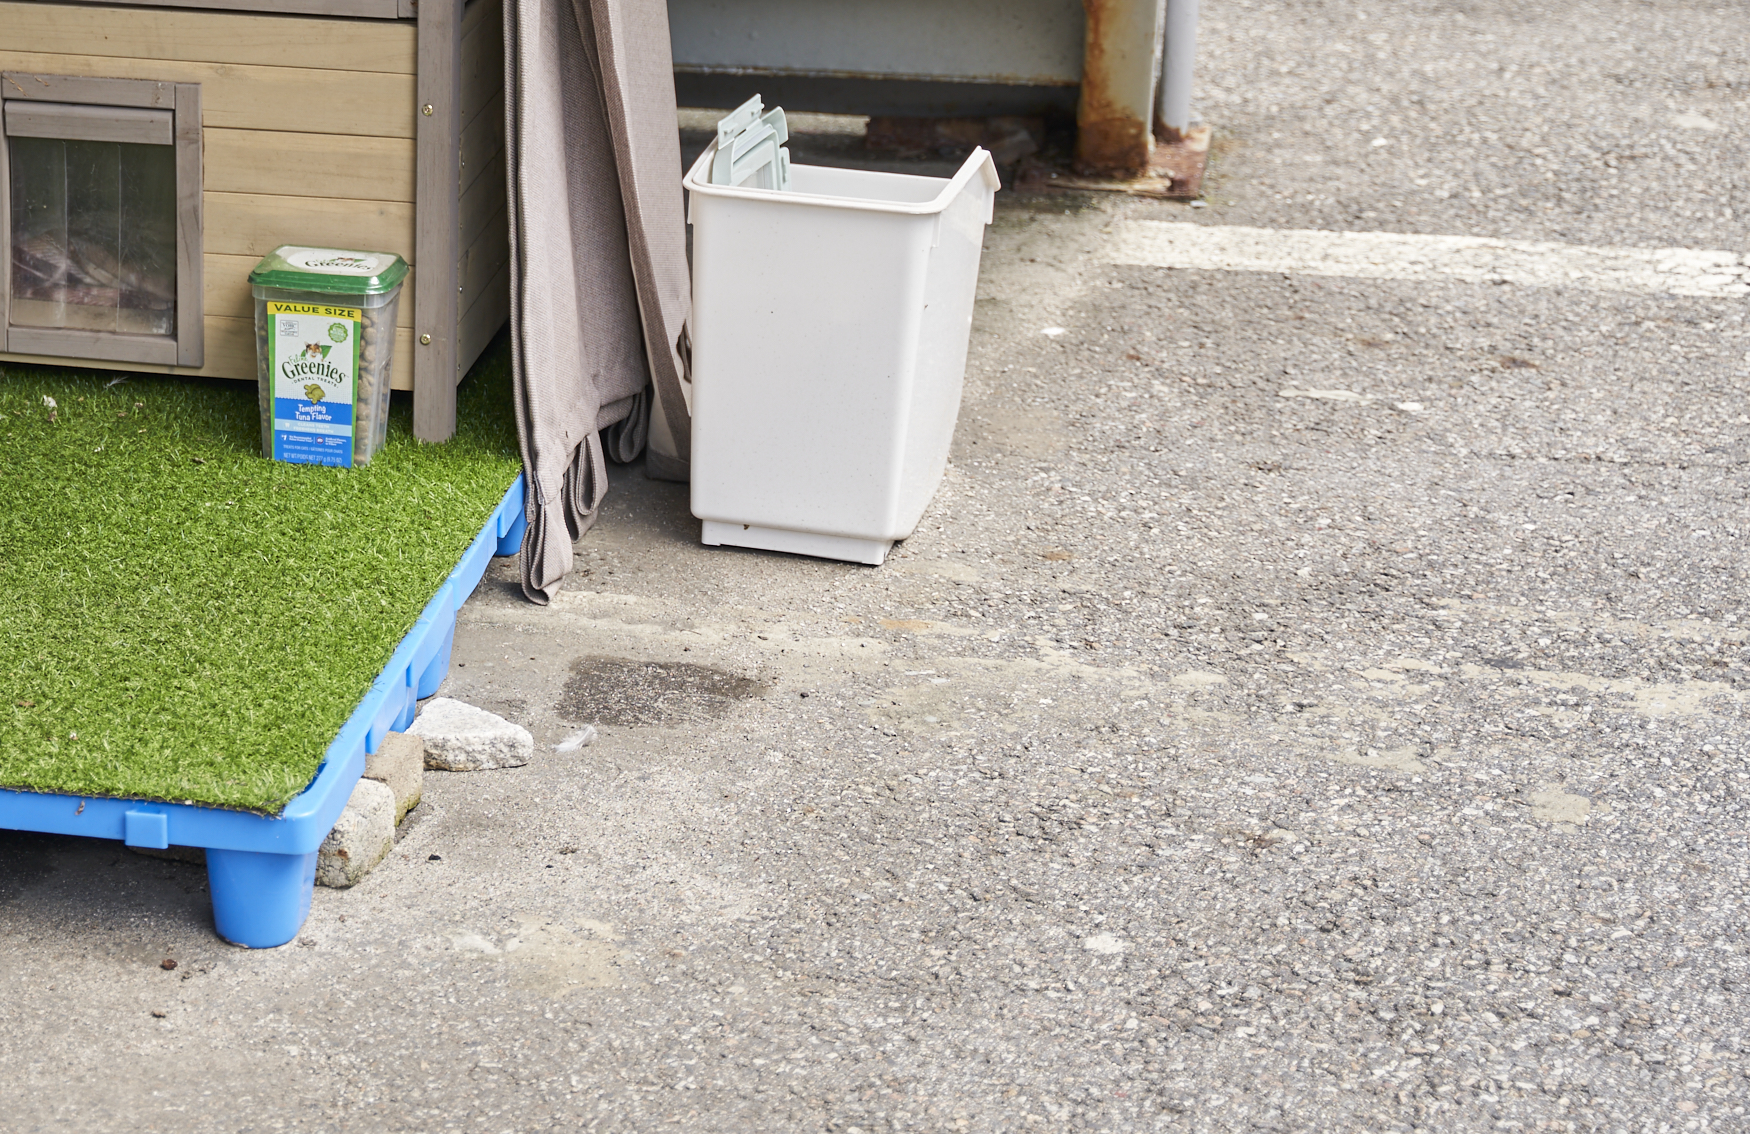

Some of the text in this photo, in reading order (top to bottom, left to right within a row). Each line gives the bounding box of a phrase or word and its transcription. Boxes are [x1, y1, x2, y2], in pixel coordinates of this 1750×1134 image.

[274, 303, 355, 318] VALUE SIZE
[281, 361, 346, 384] Greenies
[294, 376, 337, 387] DENTAL TREATS
[298, 403, 326, 414] Tempting
[295, 411, 332, 421] Tuna Flavor
